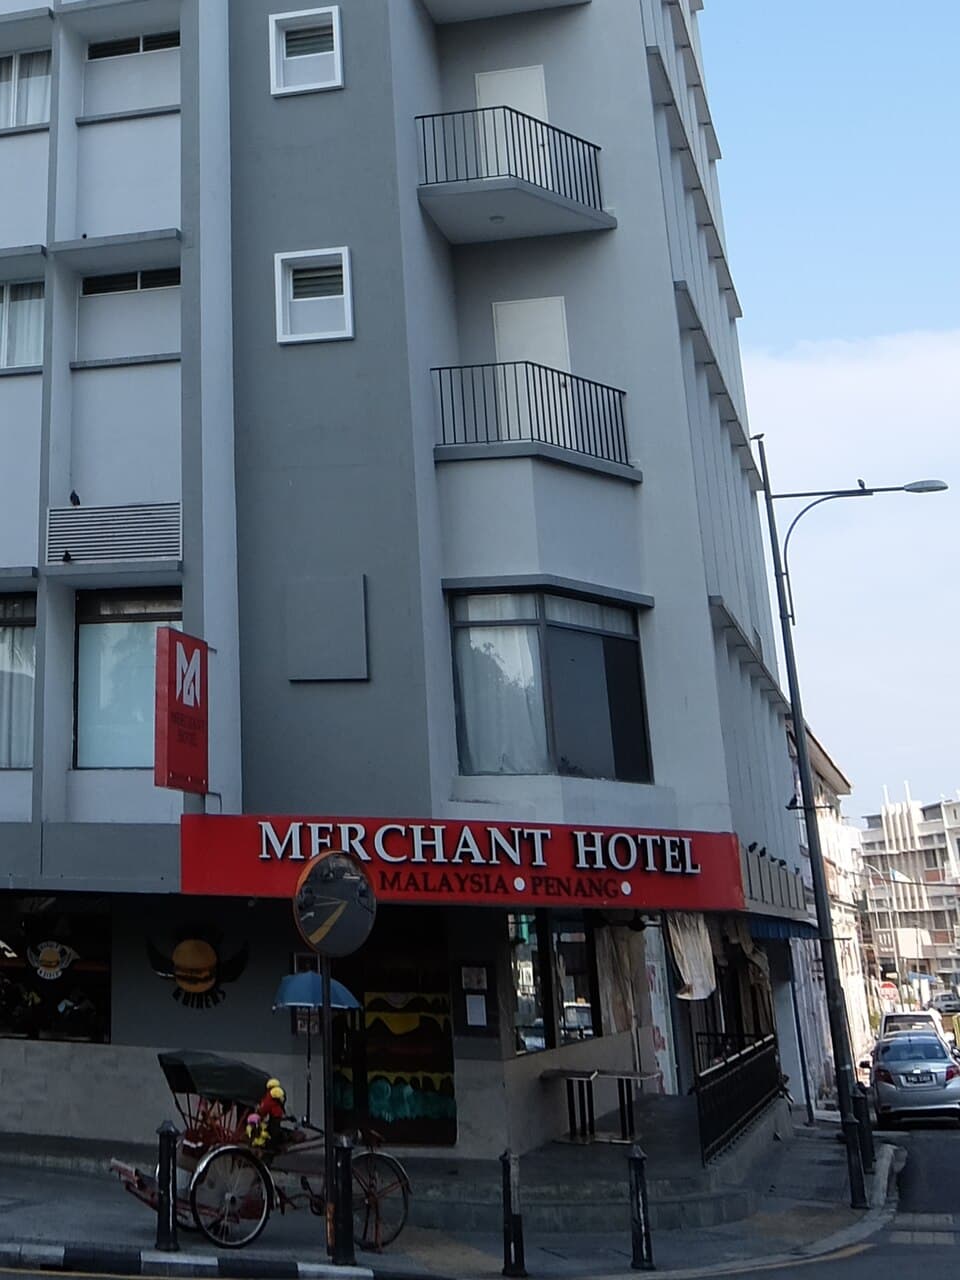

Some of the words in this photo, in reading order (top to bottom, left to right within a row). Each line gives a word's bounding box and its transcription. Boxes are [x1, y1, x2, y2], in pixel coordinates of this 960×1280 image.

[258, 821, 551, 866] MERCHANT
[573, 831, 701, 874] HOTEL
[380, 871, 508, 895] MALAYSIA
[531, 876, 618, 899] PENANG
